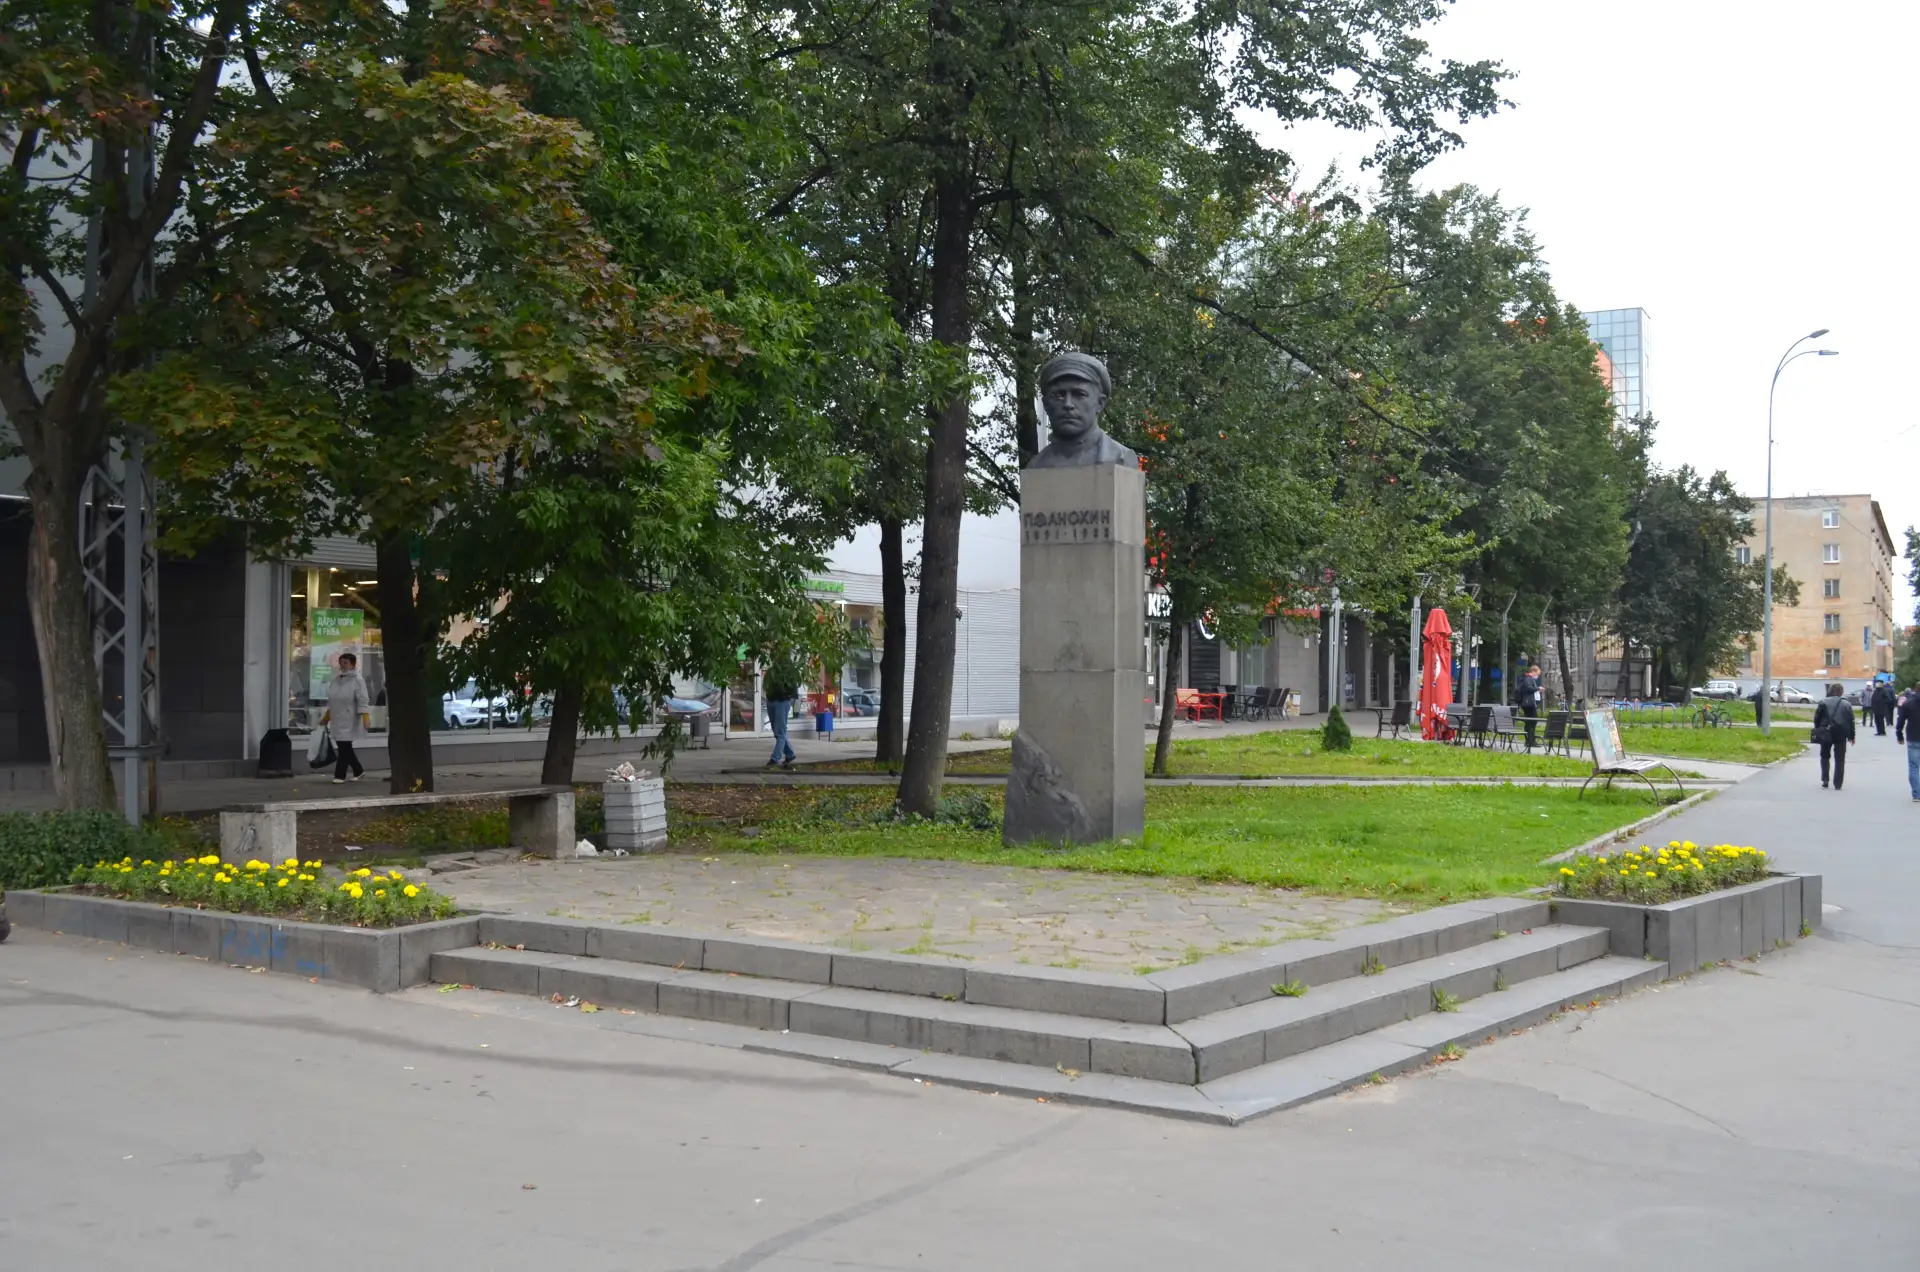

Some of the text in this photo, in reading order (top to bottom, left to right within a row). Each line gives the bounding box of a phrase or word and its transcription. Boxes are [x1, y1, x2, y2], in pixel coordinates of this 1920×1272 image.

[317, 616, 354, 627] ДАРЫ МОРЯ
[316, 627, 340, 636] И РЫБА
